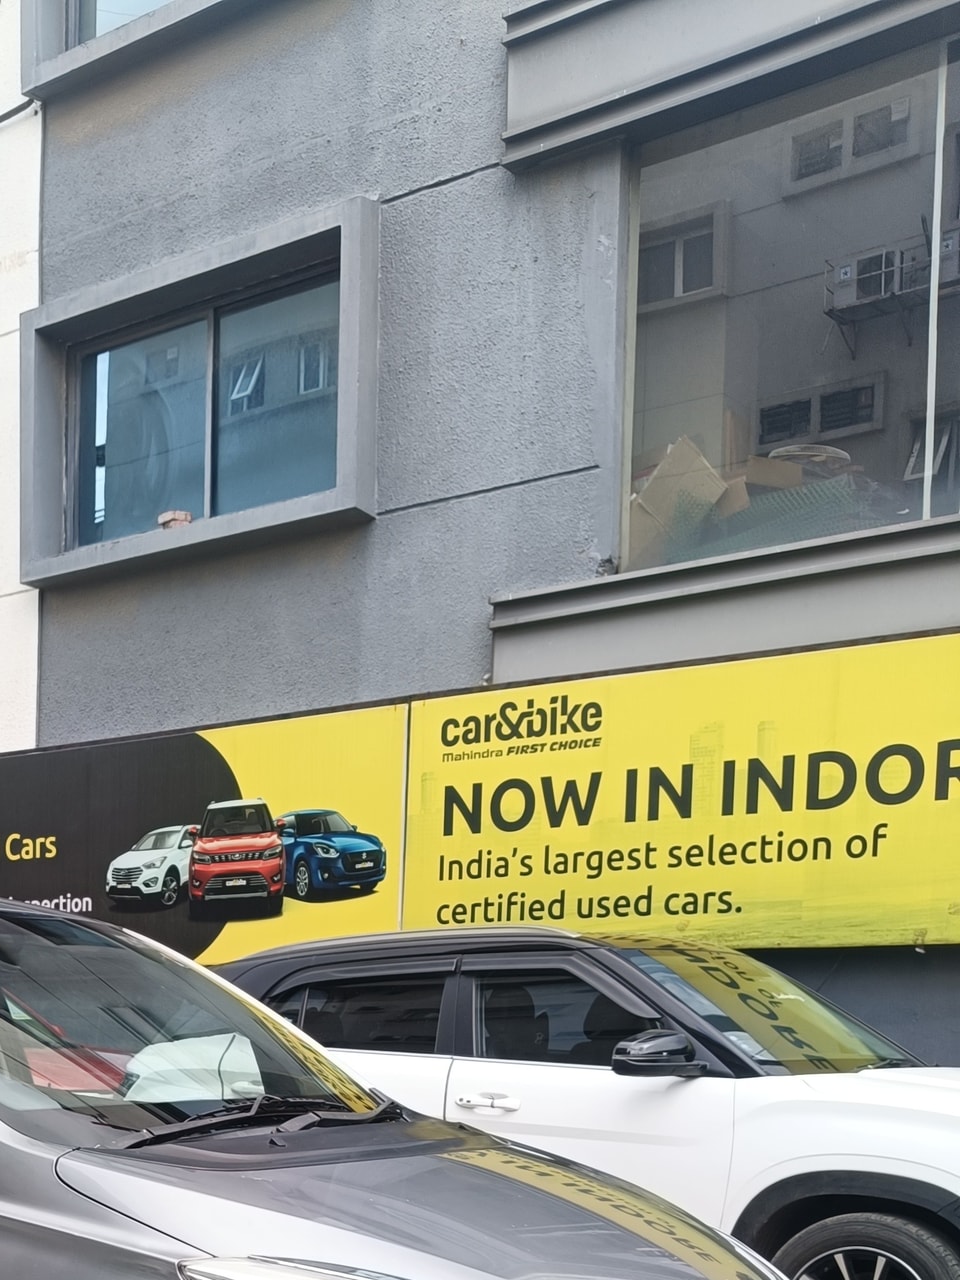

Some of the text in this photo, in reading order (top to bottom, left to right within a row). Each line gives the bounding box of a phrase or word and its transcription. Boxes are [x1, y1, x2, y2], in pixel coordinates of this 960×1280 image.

[441, 695, 602, 747] car&bike
[442, 738, 602, 762] Mahindra FIRST CHOICE
[443, 772, 602, 836] NOW
[625, 764, 693, 823] IN
[5, 833, 57, 861] Cars
[544, 842, 657, 879] largest
[668, 831, 831, 868] selection
[846, 823, 888, 860] of
[437, 885, 742, 925] certified used cars.
